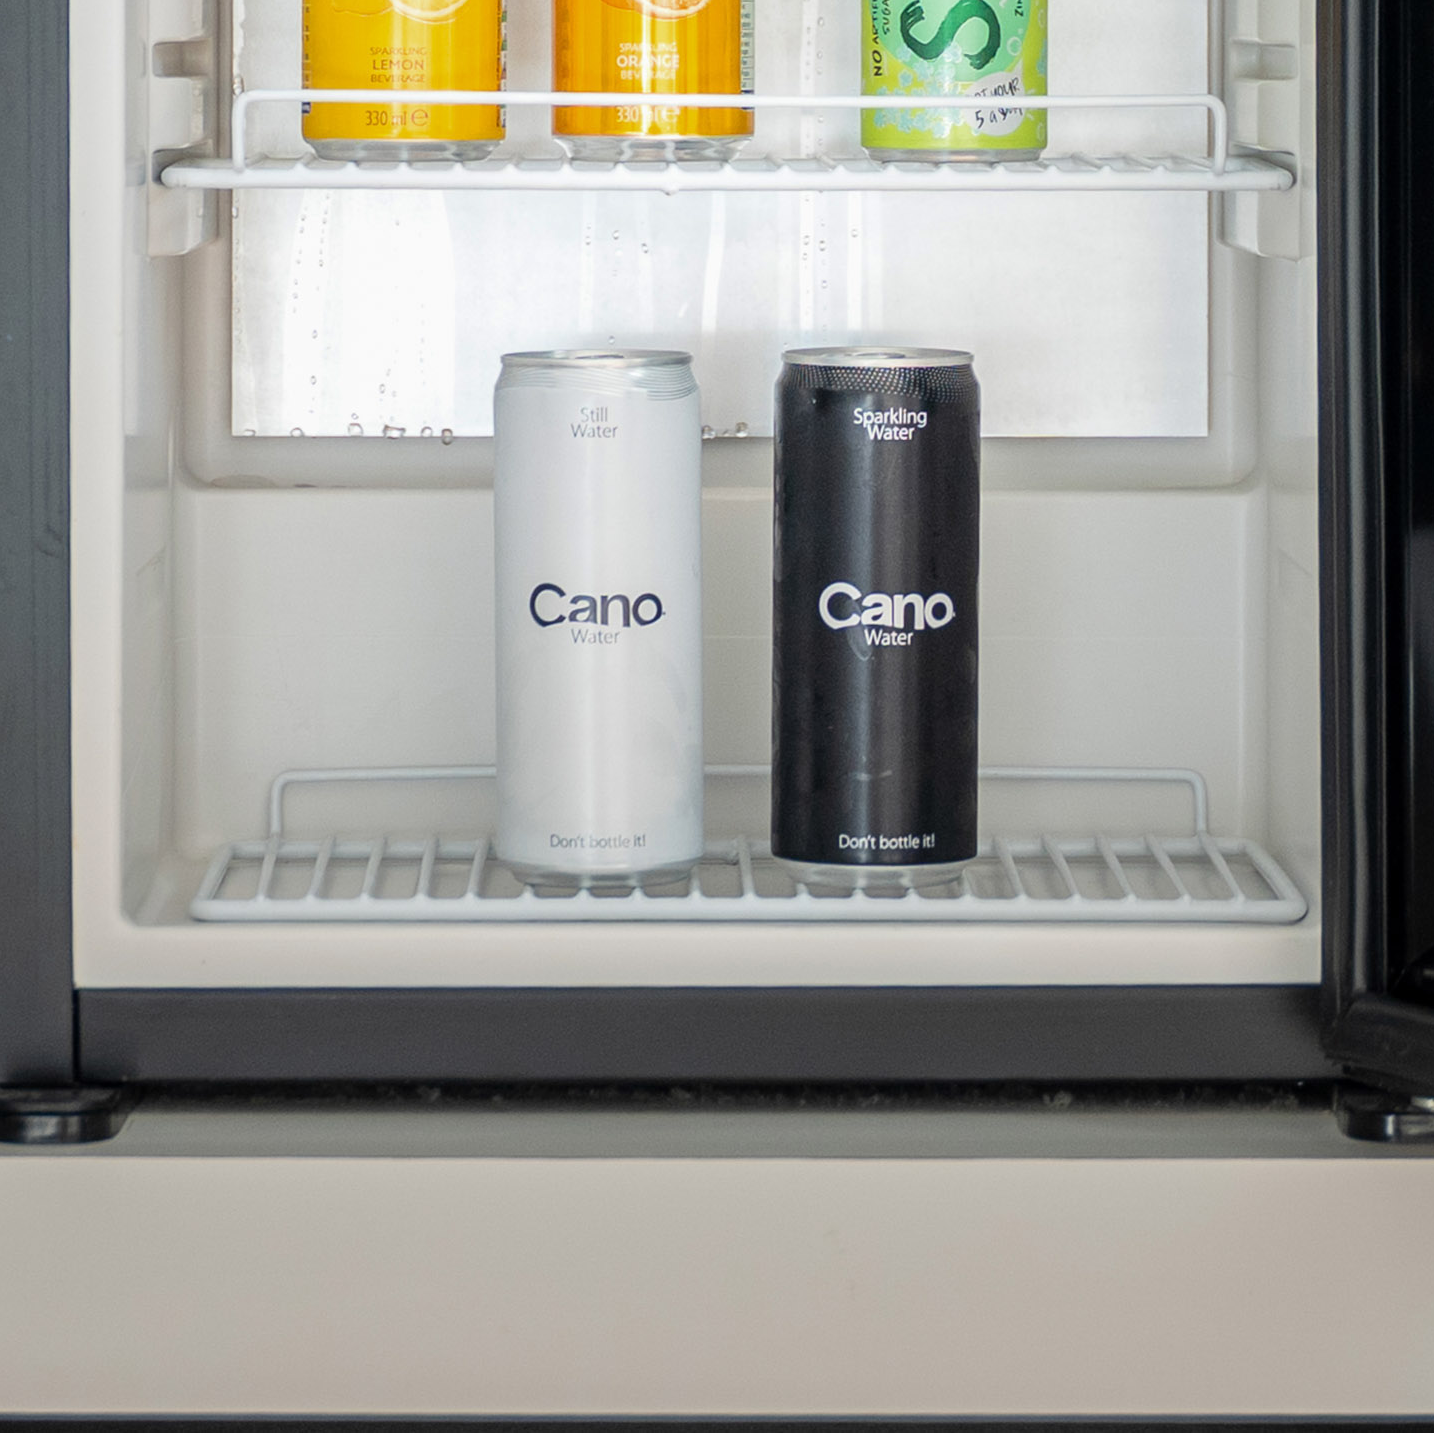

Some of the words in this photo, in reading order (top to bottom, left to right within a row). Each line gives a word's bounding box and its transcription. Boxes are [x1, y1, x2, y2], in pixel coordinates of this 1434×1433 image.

[370, 46, 427, 56] SPARKLING
[619, 42, 678, 52] SPALING
[372, 59, 424, 70] LEMON
[871, 48, 883, 76] NO
[620, 69, 676, 80] BEVRAGE
[365, 110, 388, 126] 330
[391, 110, 407, 126] ml
[616, 106, 640, 122] 330
[975, 109, 984, 129] 5
[580, 407, 608, 423] Still
[853, 407, 928, 429] Sparkling
[570, 423, 619, 438] Water
[867, 425, 915, 441] Water
[529, 582, 664, 628] Cano
[819, 581, 954, 630] Cano
[570, 628, 620, 644] Water
[864, 628, 914, 646] Water
[550, 833, 585, 848] Don't
[589, 834, 630, 849] bottle
[633, 833, 647, 847] it!
[838, 833, 876, 849] Don't
[879, 834, 920, 850] bottle
[922, 833, 936, 848] it!
